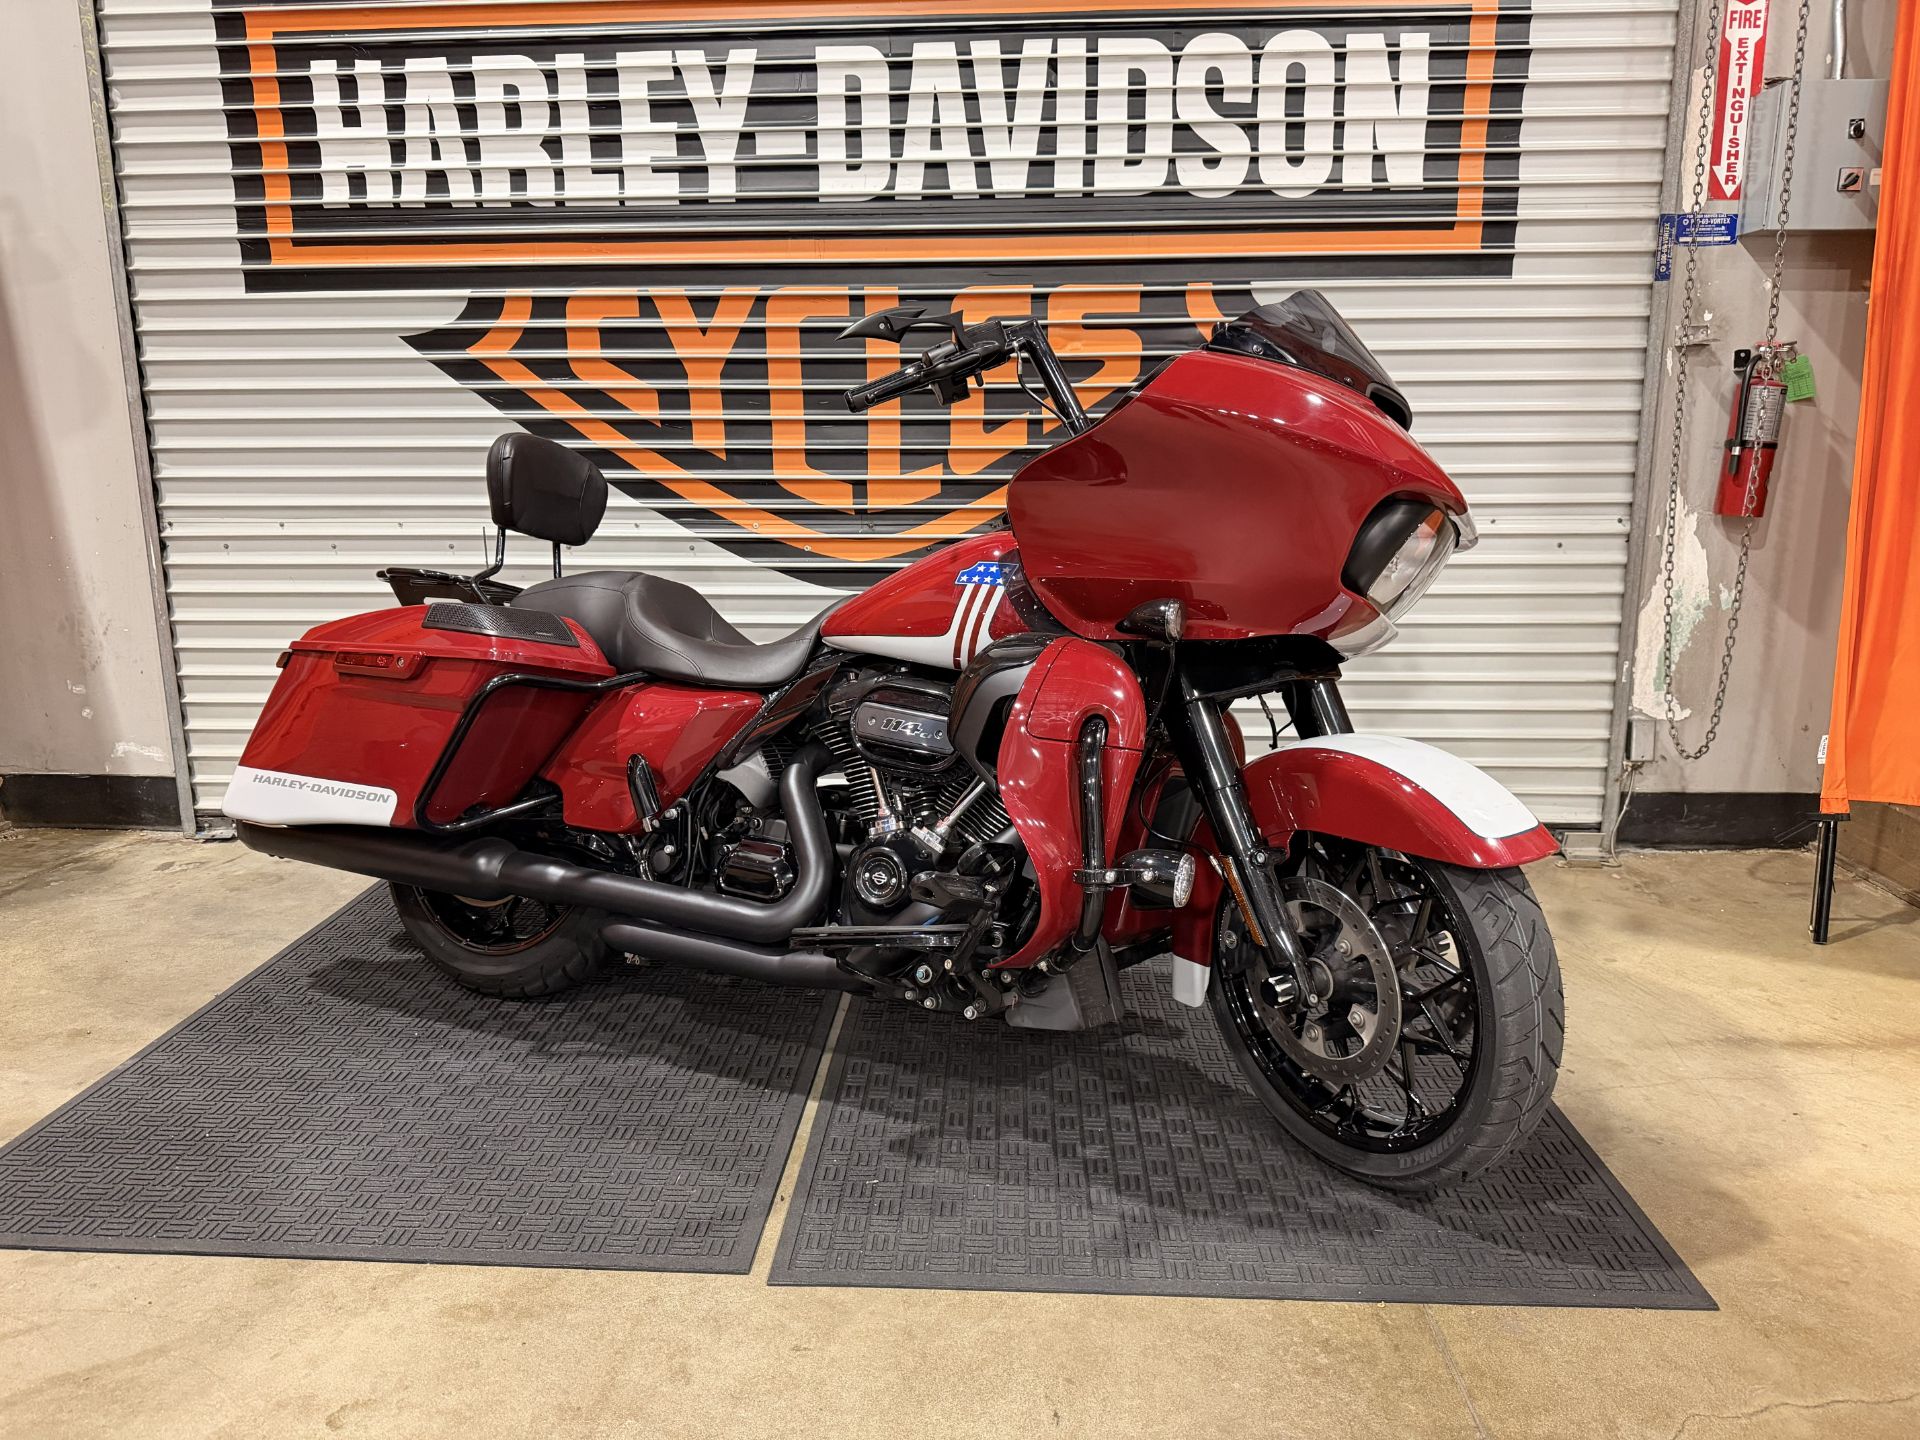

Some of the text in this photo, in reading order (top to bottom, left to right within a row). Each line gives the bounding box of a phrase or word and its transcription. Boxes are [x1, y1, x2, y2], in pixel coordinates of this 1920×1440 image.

[1729, 9, 1762, 30] FIRE
[310, 30, 1431, 208] HARLEY-DAVIDSON
[1724, 37, 1750, 186] EXTINGUISHER
[565, 283, 1145, 514] CYCLES
[881, 717, 923, 736] 114
[252, 773, 391, 804] HARLEY-DAVIDSON
[1399, 1126, 1464, 1168] SHINKO
